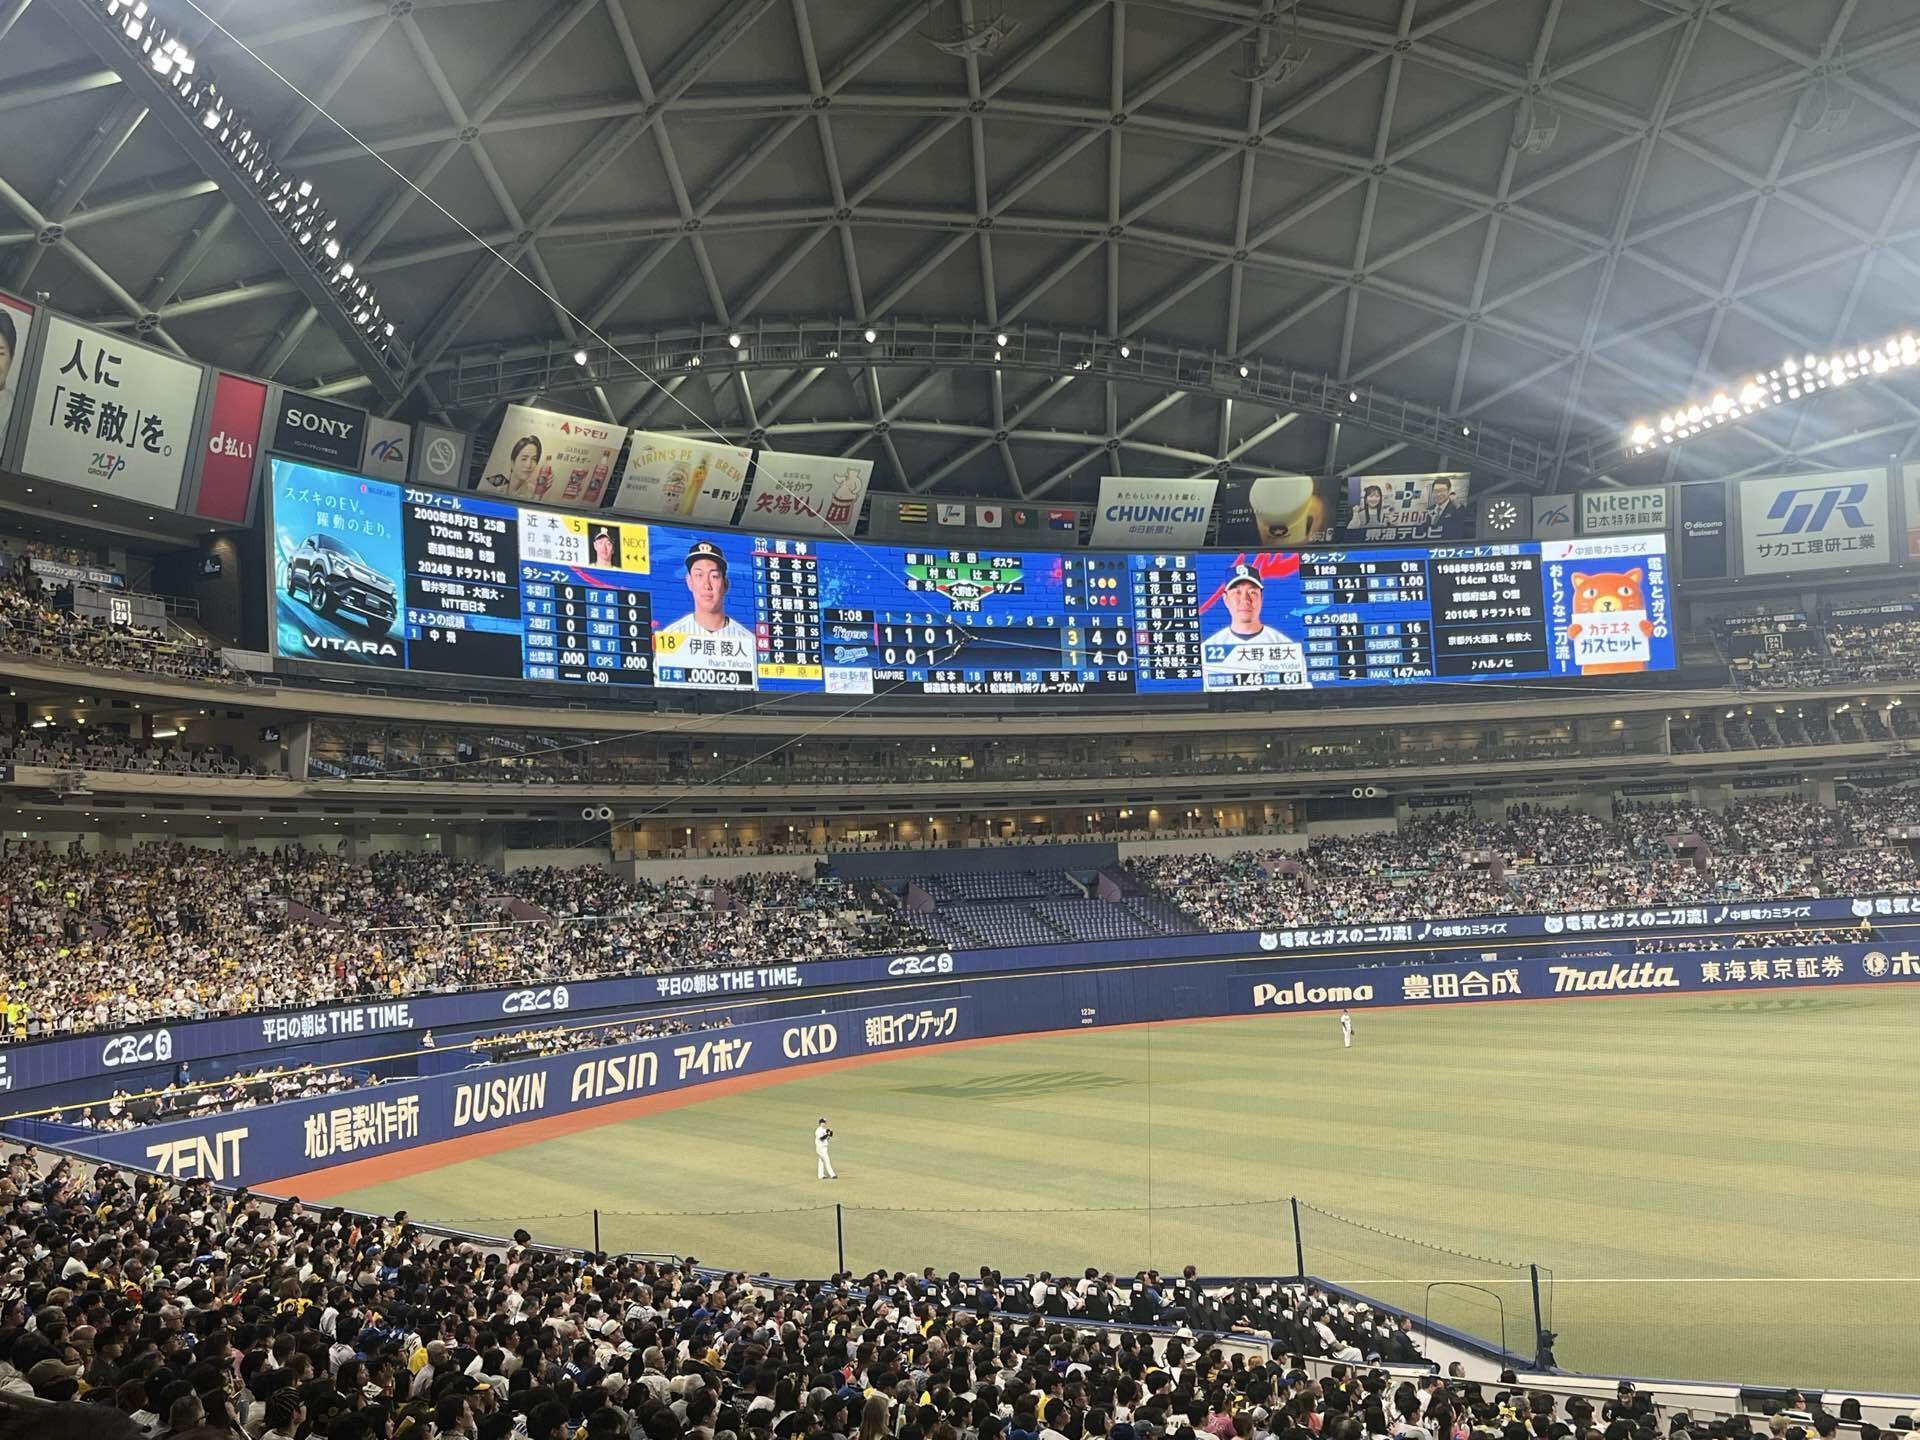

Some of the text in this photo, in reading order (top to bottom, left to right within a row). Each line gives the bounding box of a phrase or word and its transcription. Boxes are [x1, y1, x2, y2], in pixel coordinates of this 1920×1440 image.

[59, 338, 122, 388] 人に
[50, 385, 172, 457] 「素敵」を。
[286, 409, 353, 439] SONY
[574, 425, 608, 440] ヤマモリ
[209, 432, 252, 458] d払い
[633, 449, 676, 470] KIRIN'S
[714, 459, 741, 482] BREW
[776, 480, 813, 492] みそかつ
[285, 487, 364, 515] スズキのEV。
[405, 490, 461, 509] プロフィール
[702, 489, 740, 503] 一番搾り
[1587, 493, 1663, 515] Niterra
[414, 508, 506, 533] 2000年8月7日 25歳
[527, 514, 581, 532] 近本 5
[1105, 505, 1206, 523] CHUNICHI
[1586, 512, 1663, 528] 日本特殊陶業
[316, 511, 391, 539] 躍動の走り。
[1128, 525, 1174, 535] 中日新聞社
[1365, 526, 1444, 541] 東海テレビ
[1689, 529, 1719, 537] Business
[429, 526, 492, 547] 170cm 75kg
[555, 536, 579, 548] .283
[622, 536, 647, 548] NEXT
[555, 550, 579, 562] .231
[1575, 542, 1647, 555] 中部電力ミライズ
[769, 557, 801, 570] 近本
[1155, 555, 1186, 569] 中日
[1301, 553, 1346, 564] 今シーズン
[418, 561, 506, 584] 2024年 ドラフト1位
[522, 566, 569, 583] 今シーズン
[1437, 562, 1505, 574] 1988年9月26日
[770, 571, 802, 584] 中野
[1338, 577, 1424, 588] 12.1 1.00
[1455, 574, 1516, 585] 184cm 85kg
[441, 599, 486, 612] NTT西日本
[565, 587, 636, 606] 0 0
[1346, 591, 1423, 603] 7 5.11
[1648, 558, 1667, 638] 電気とガスの
[566, 603, 636, 622] 0 0
[772, 611, 804, 623] 大山
[838, 610, 863, 621] 1:08
[885, 613, 1123, 626] 1 2 3 4 5 6 7 8 9 R H E
[1304, 612, 1358, 624] きょうの成績
[1445, 607, 1531, 620] 2010年 ドラフト1位
[567, 619, 637, 638] 0 0
[1152, 621, 1184, 630] サノー
[1341, 623, 1421, 636] 3.1 16
[1587, 623, 1630, 636] カテエネ
[303, 634, 397, 656] VITARA
[568, 635, 636, 653] 0 1
[660, 635, 748, 657] 18 伊原 陵人
[773, 638, 805, 651] 中川
[885, 628, 1126, 646] 1 1 0 1 3 4 0
[1153, 632, 1185, 643] 村松
[1347, 638, 1419, 650] 1 3
[1580, 636, 1642, 654] ガスセット
[560, 651, 647, 669] .000 OPS .000
[885, 648, 1127, 666] 0 0 1 1 4 0
[1207, 647, 1296, 662] 22 大野 雄大
[1348, 652, 1420, 665] 4 2
[874, 670, 1127, 681] UMPIRE 松本 1B 石山
[1236, 673, 1299, 685] 1.46 60
[1349, 670, 1390, 680] 2 MAX
[1729, 906, 1811, 921] 中部電力ミライズ
[1432, 923, 1507, 938] 中部電力ミライズ
[887, 955, 938, 976] CBC
[1700, 955, 1844, 984] 東海東京証券
[1891, 951, 1920, 975] ホ
[656, 966, 803, 997] 平日の朝は THE TIME,
[1401, 968, 1522, 999] 豊田合成
[1548, 961, 1680, 993] Makita
[501, 988, 552, 1014] CBC
[1252, 981, 1373, 1007] Paloma
[261, 1003, 415, 1044] 平日の朝は THE TIME,
[864, 1007, 958, 1047] 朝日インテック
[103, 1034, 152, 1066] CBC
[782, 1023, 838, 1059] CKD
[674, 1038, 753, 1080] アイホン
[570, 1051, 658, 1102] AISIN
[304, 1094, 420, 1160] 松尾製作所
